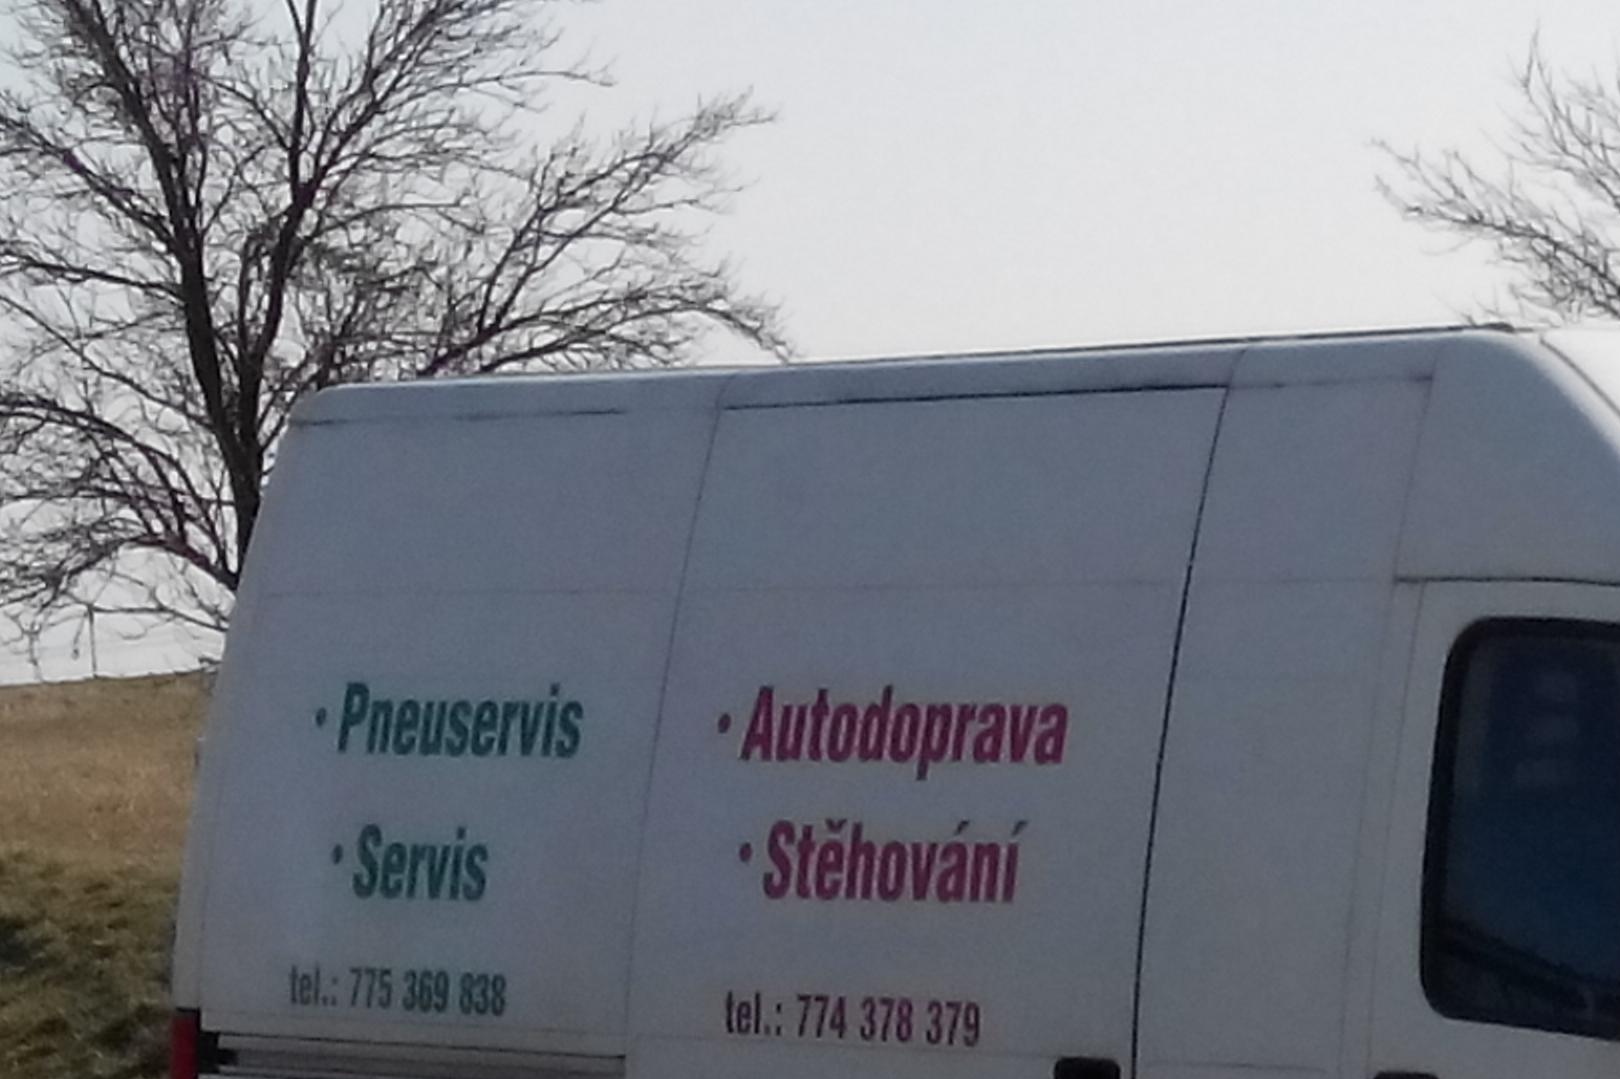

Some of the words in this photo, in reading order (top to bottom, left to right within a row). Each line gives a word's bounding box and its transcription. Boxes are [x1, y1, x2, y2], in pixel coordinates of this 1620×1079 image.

[337, 682, 584, 758] Pneuservis
[739, 684, 1070, 781] Autodoprava
[352, 823, 489, 901] Servis
[763, 817, 1028, 903] Stěhování
[289, 963, 338, 1006] tel.:
[349, 967, 392, 1009] 775
[402, 970, 450, 1013] 369
[459, 973, 507, 1017] 838
[725, 991, 782, 1036] tel.:
[797, 995, 846, 1039] 774
[859, 997, 914, 1043] 378
[926, 1001, 981, 1047] 379
